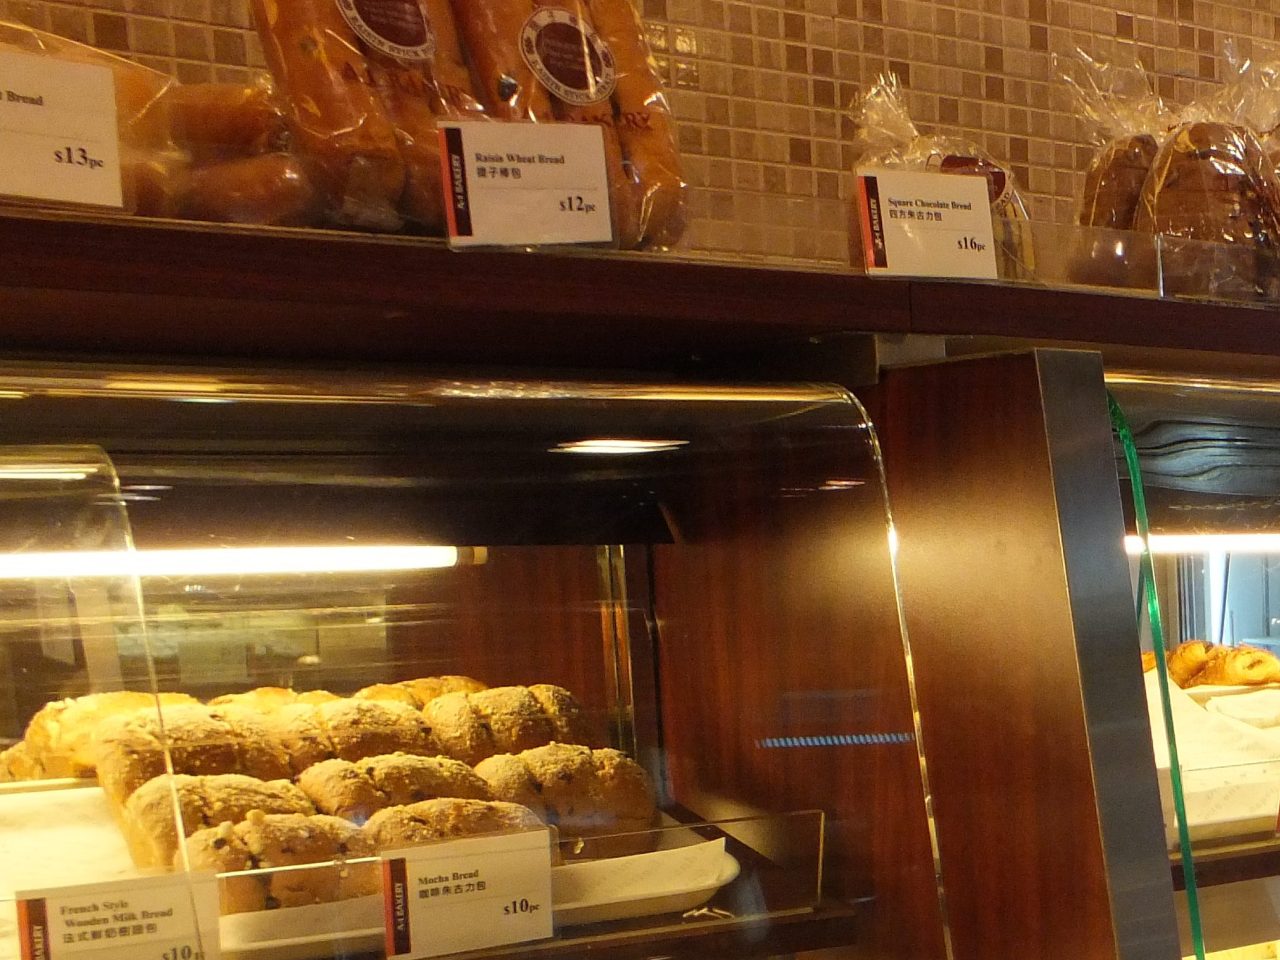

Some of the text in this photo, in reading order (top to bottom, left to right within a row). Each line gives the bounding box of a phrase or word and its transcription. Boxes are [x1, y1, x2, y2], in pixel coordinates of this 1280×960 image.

[475, 153, 565, 164] Raisin Wheat Bread
[888, 197, 972, 211] Square Chocolate Bread
[418, 869, 479, 885] Mocha Bread
[60, 900, 129, 916] French Style
[141, 908, 173, 920] Bread
